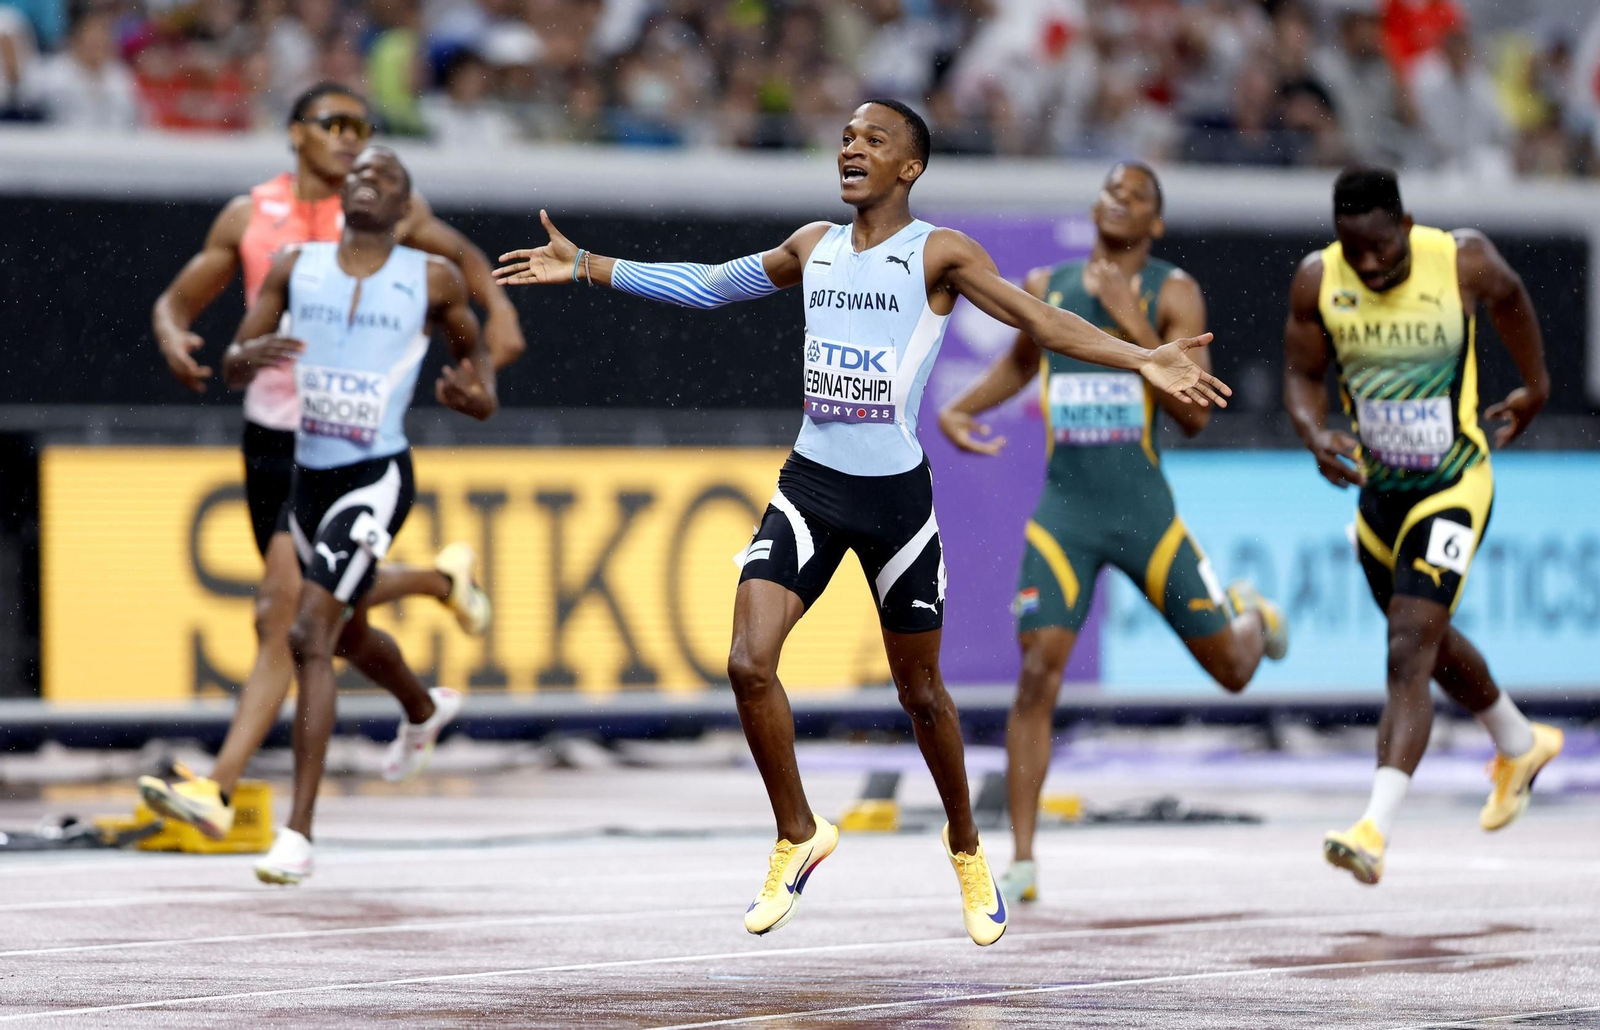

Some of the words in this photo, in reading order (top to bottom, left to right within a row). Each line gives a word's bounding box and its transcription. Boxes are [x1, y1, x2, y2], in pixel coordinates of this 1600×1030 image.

[809, 289, 900, 313] BOTSWANA
[1337, 321, 1448, 346] JAMAICA
[821, 341, 888, 373] TDK
[322, 370, 380, 397] TDK
[804, 367, 892, 403] EBINATSHIPI
[303, 396, 380, 426] NDORI
[1060, 402, 1128, 423] NENE
[1380, 401, 1442, 426] TDK
[1443, 533, 1460, 561] 6
